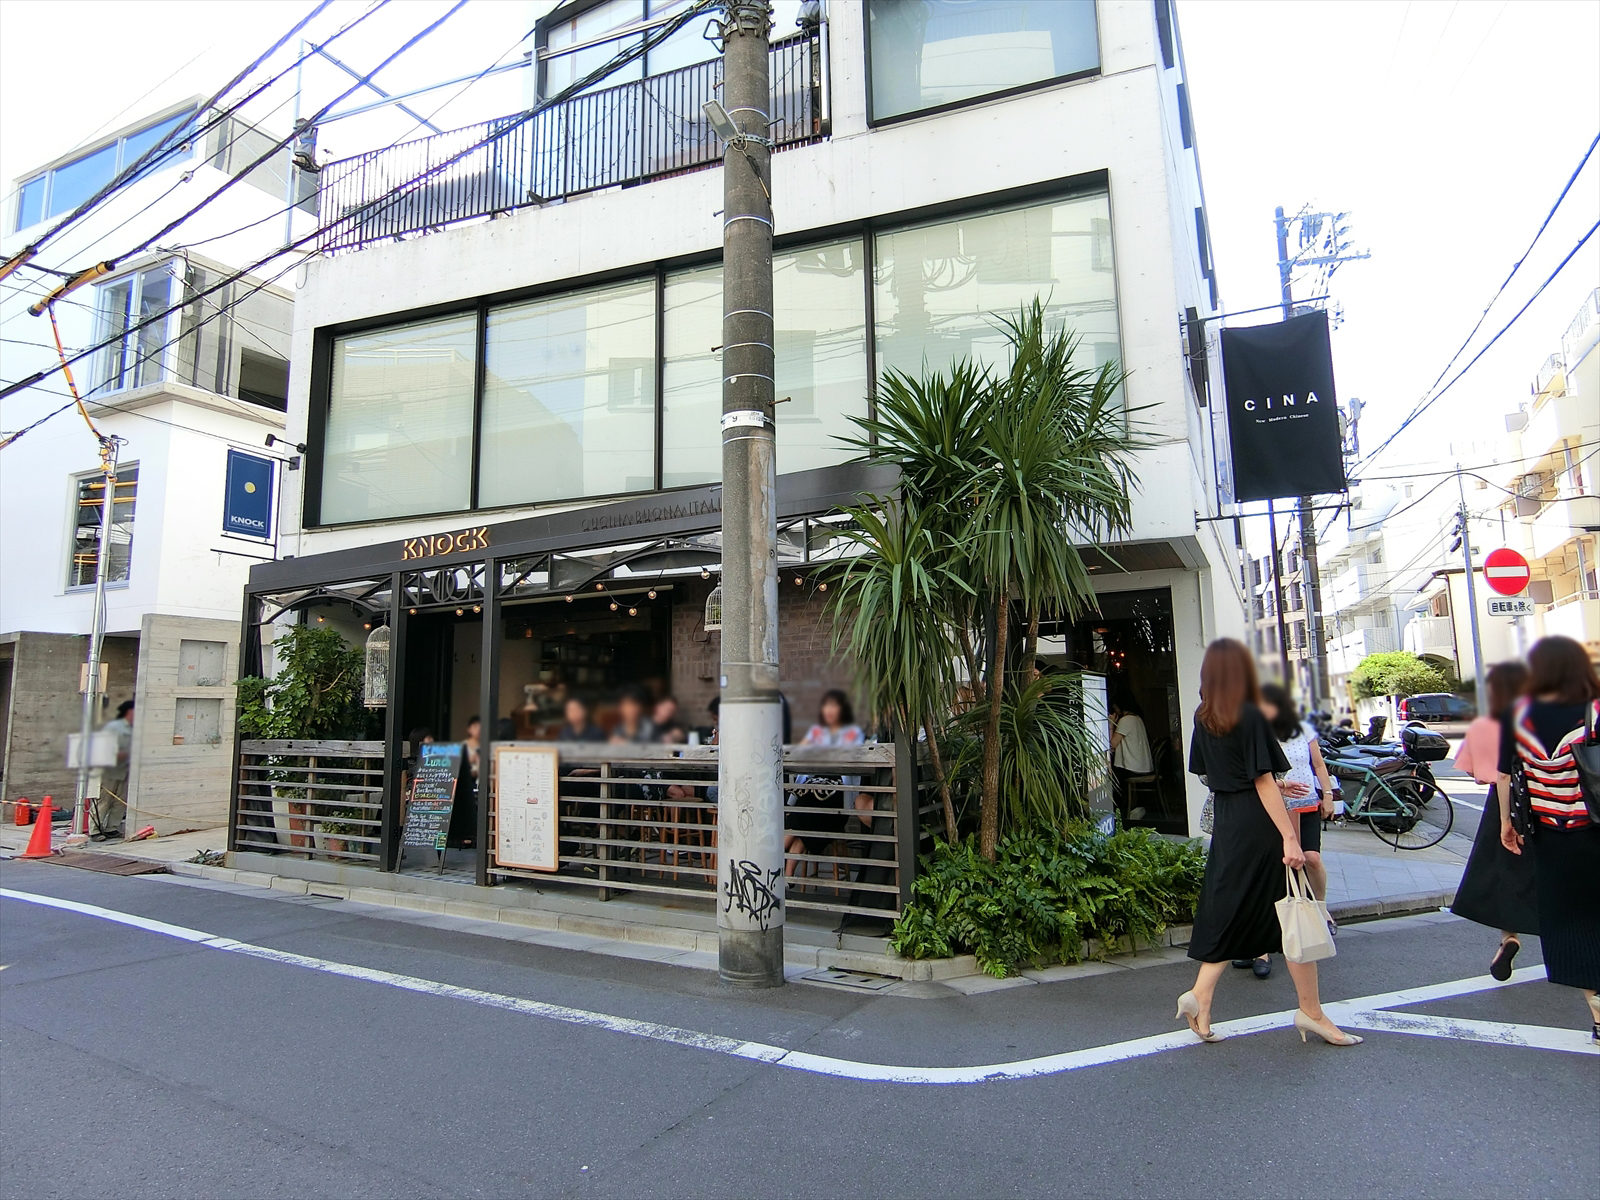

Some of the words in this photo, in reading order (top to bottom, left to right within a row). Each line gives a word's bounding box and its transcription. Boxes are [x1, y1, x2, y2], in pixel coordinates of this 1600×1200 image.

[1244, 391, 1319, 411] CINA
[1268, 415, 1287, 423] Modern
[635, 504, 684, 523] BUONA
[689, 497, 722, 515] ITALI
[231, 516, 264, 527] KNOCK
[401, 526, 489, 561] KNOCK
[1492, 601, 1531, 612] 自転車を除く
